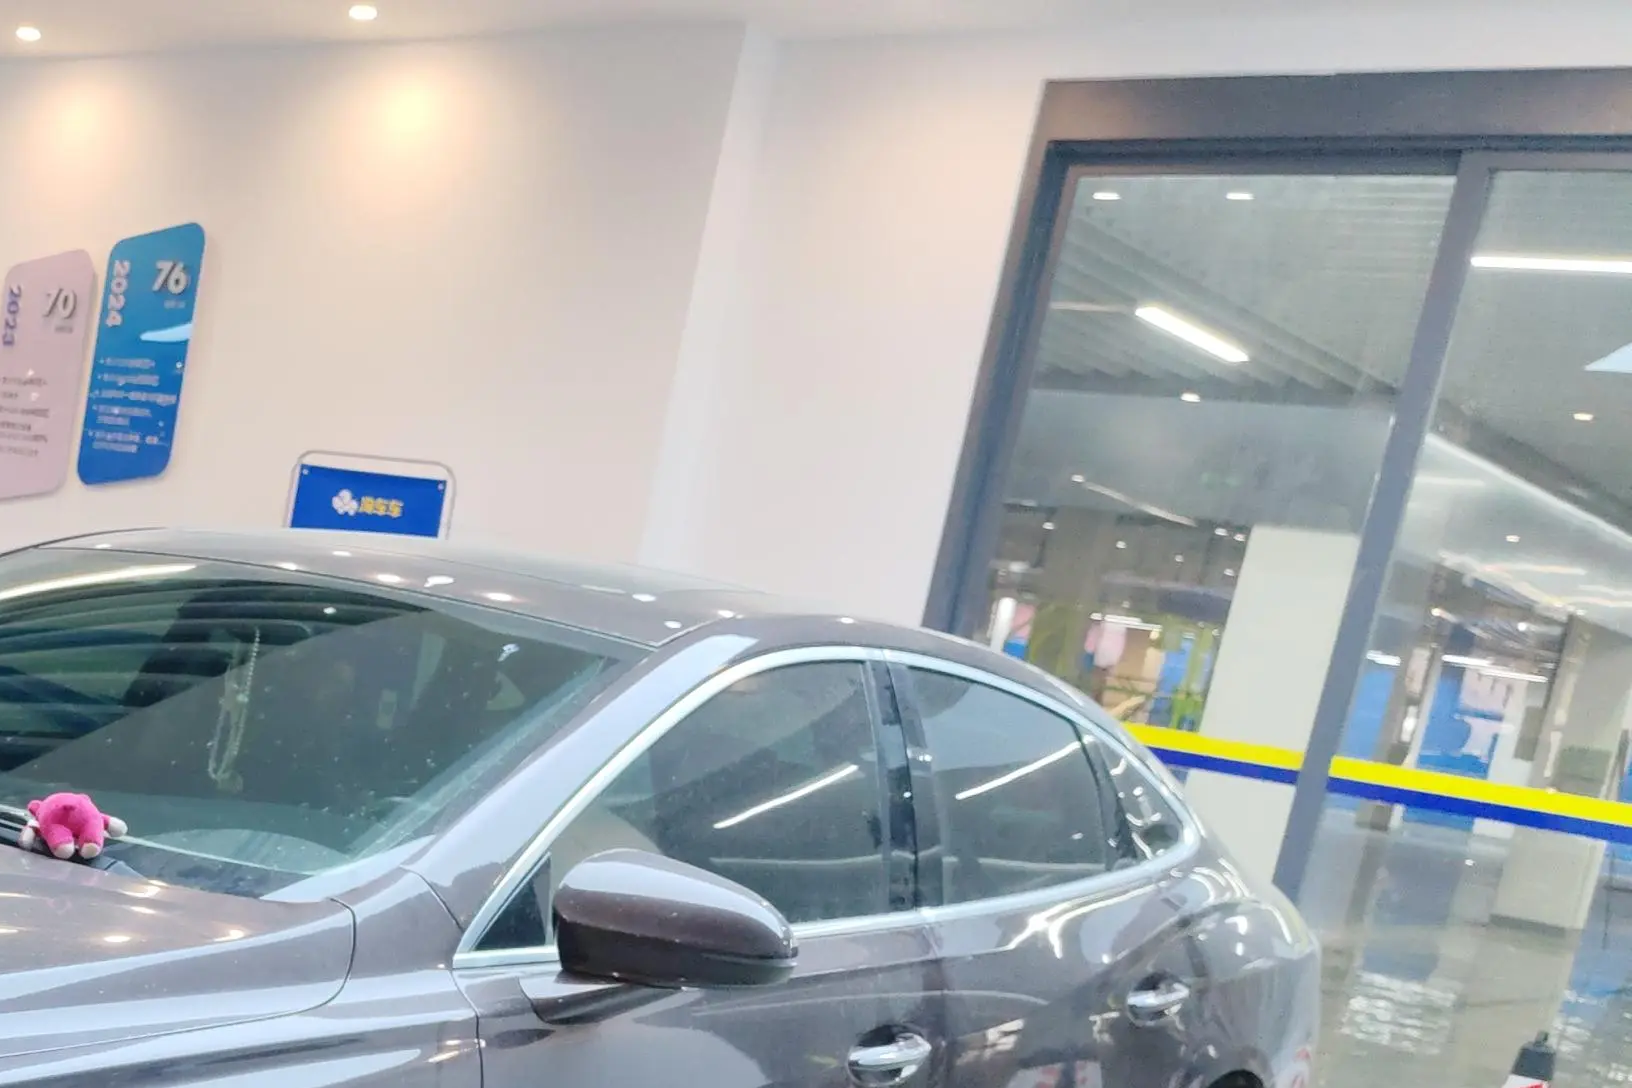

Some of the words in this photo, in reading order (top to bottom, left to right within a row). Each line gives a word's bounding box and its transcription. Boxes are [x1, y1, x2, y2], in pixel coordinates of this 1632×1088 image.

[105, 260, 131, 327] 2024
[152, 260, 188, 295] 76
[1, 284, 22, 347] 2023
